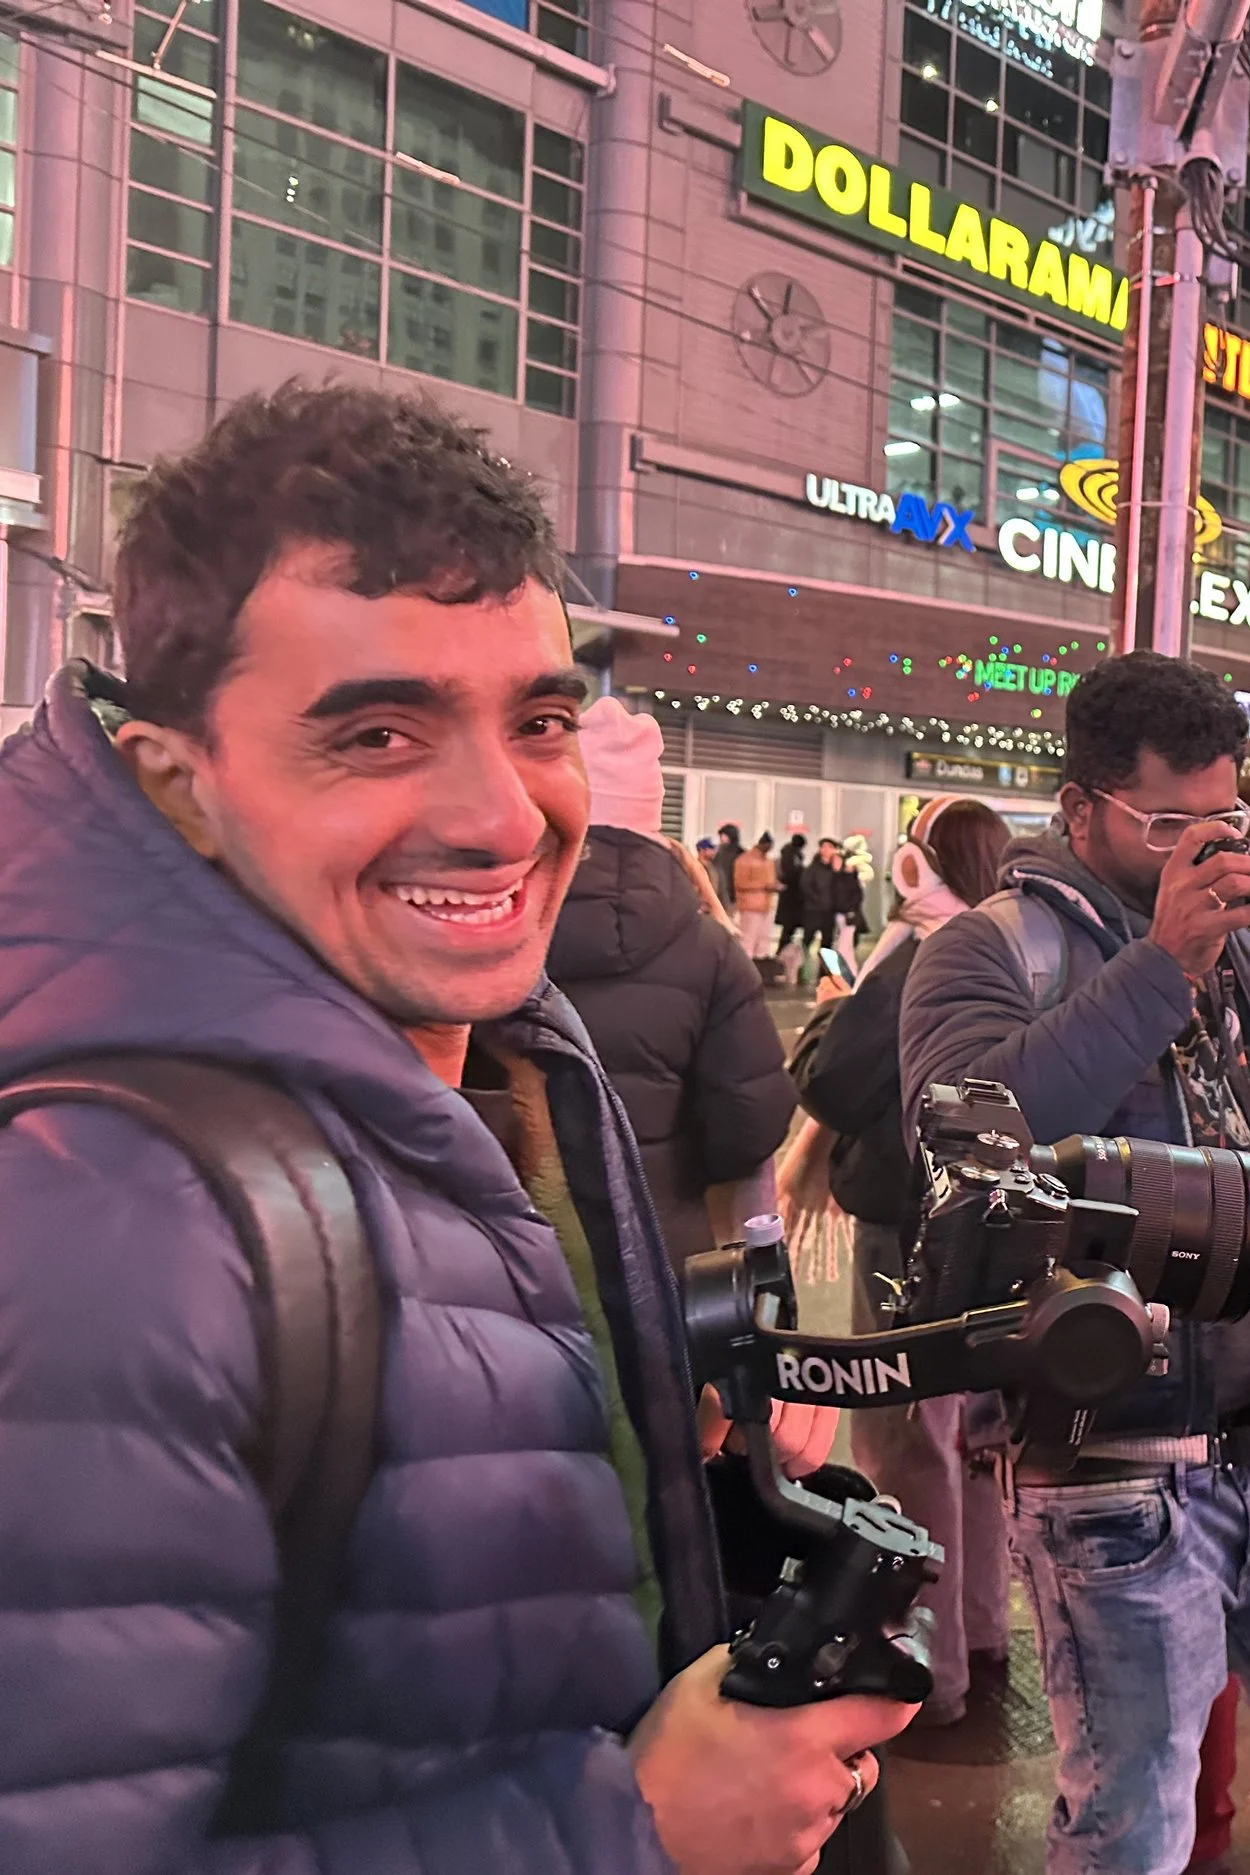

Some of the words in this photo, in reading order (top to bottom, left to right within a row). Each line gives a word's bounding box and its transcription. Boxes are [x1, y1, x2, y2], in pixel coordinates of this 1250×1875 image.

[806, 473, 897, 525] ULTRA
[890, 491, 977, 553] AVX
[974, 659, 1029, 692] MEET
[1028, 667, 1057, 695] UP
[1171, 1250, 1201, 1260] SONY
[776, 1352, 912, 1395] RONIN
